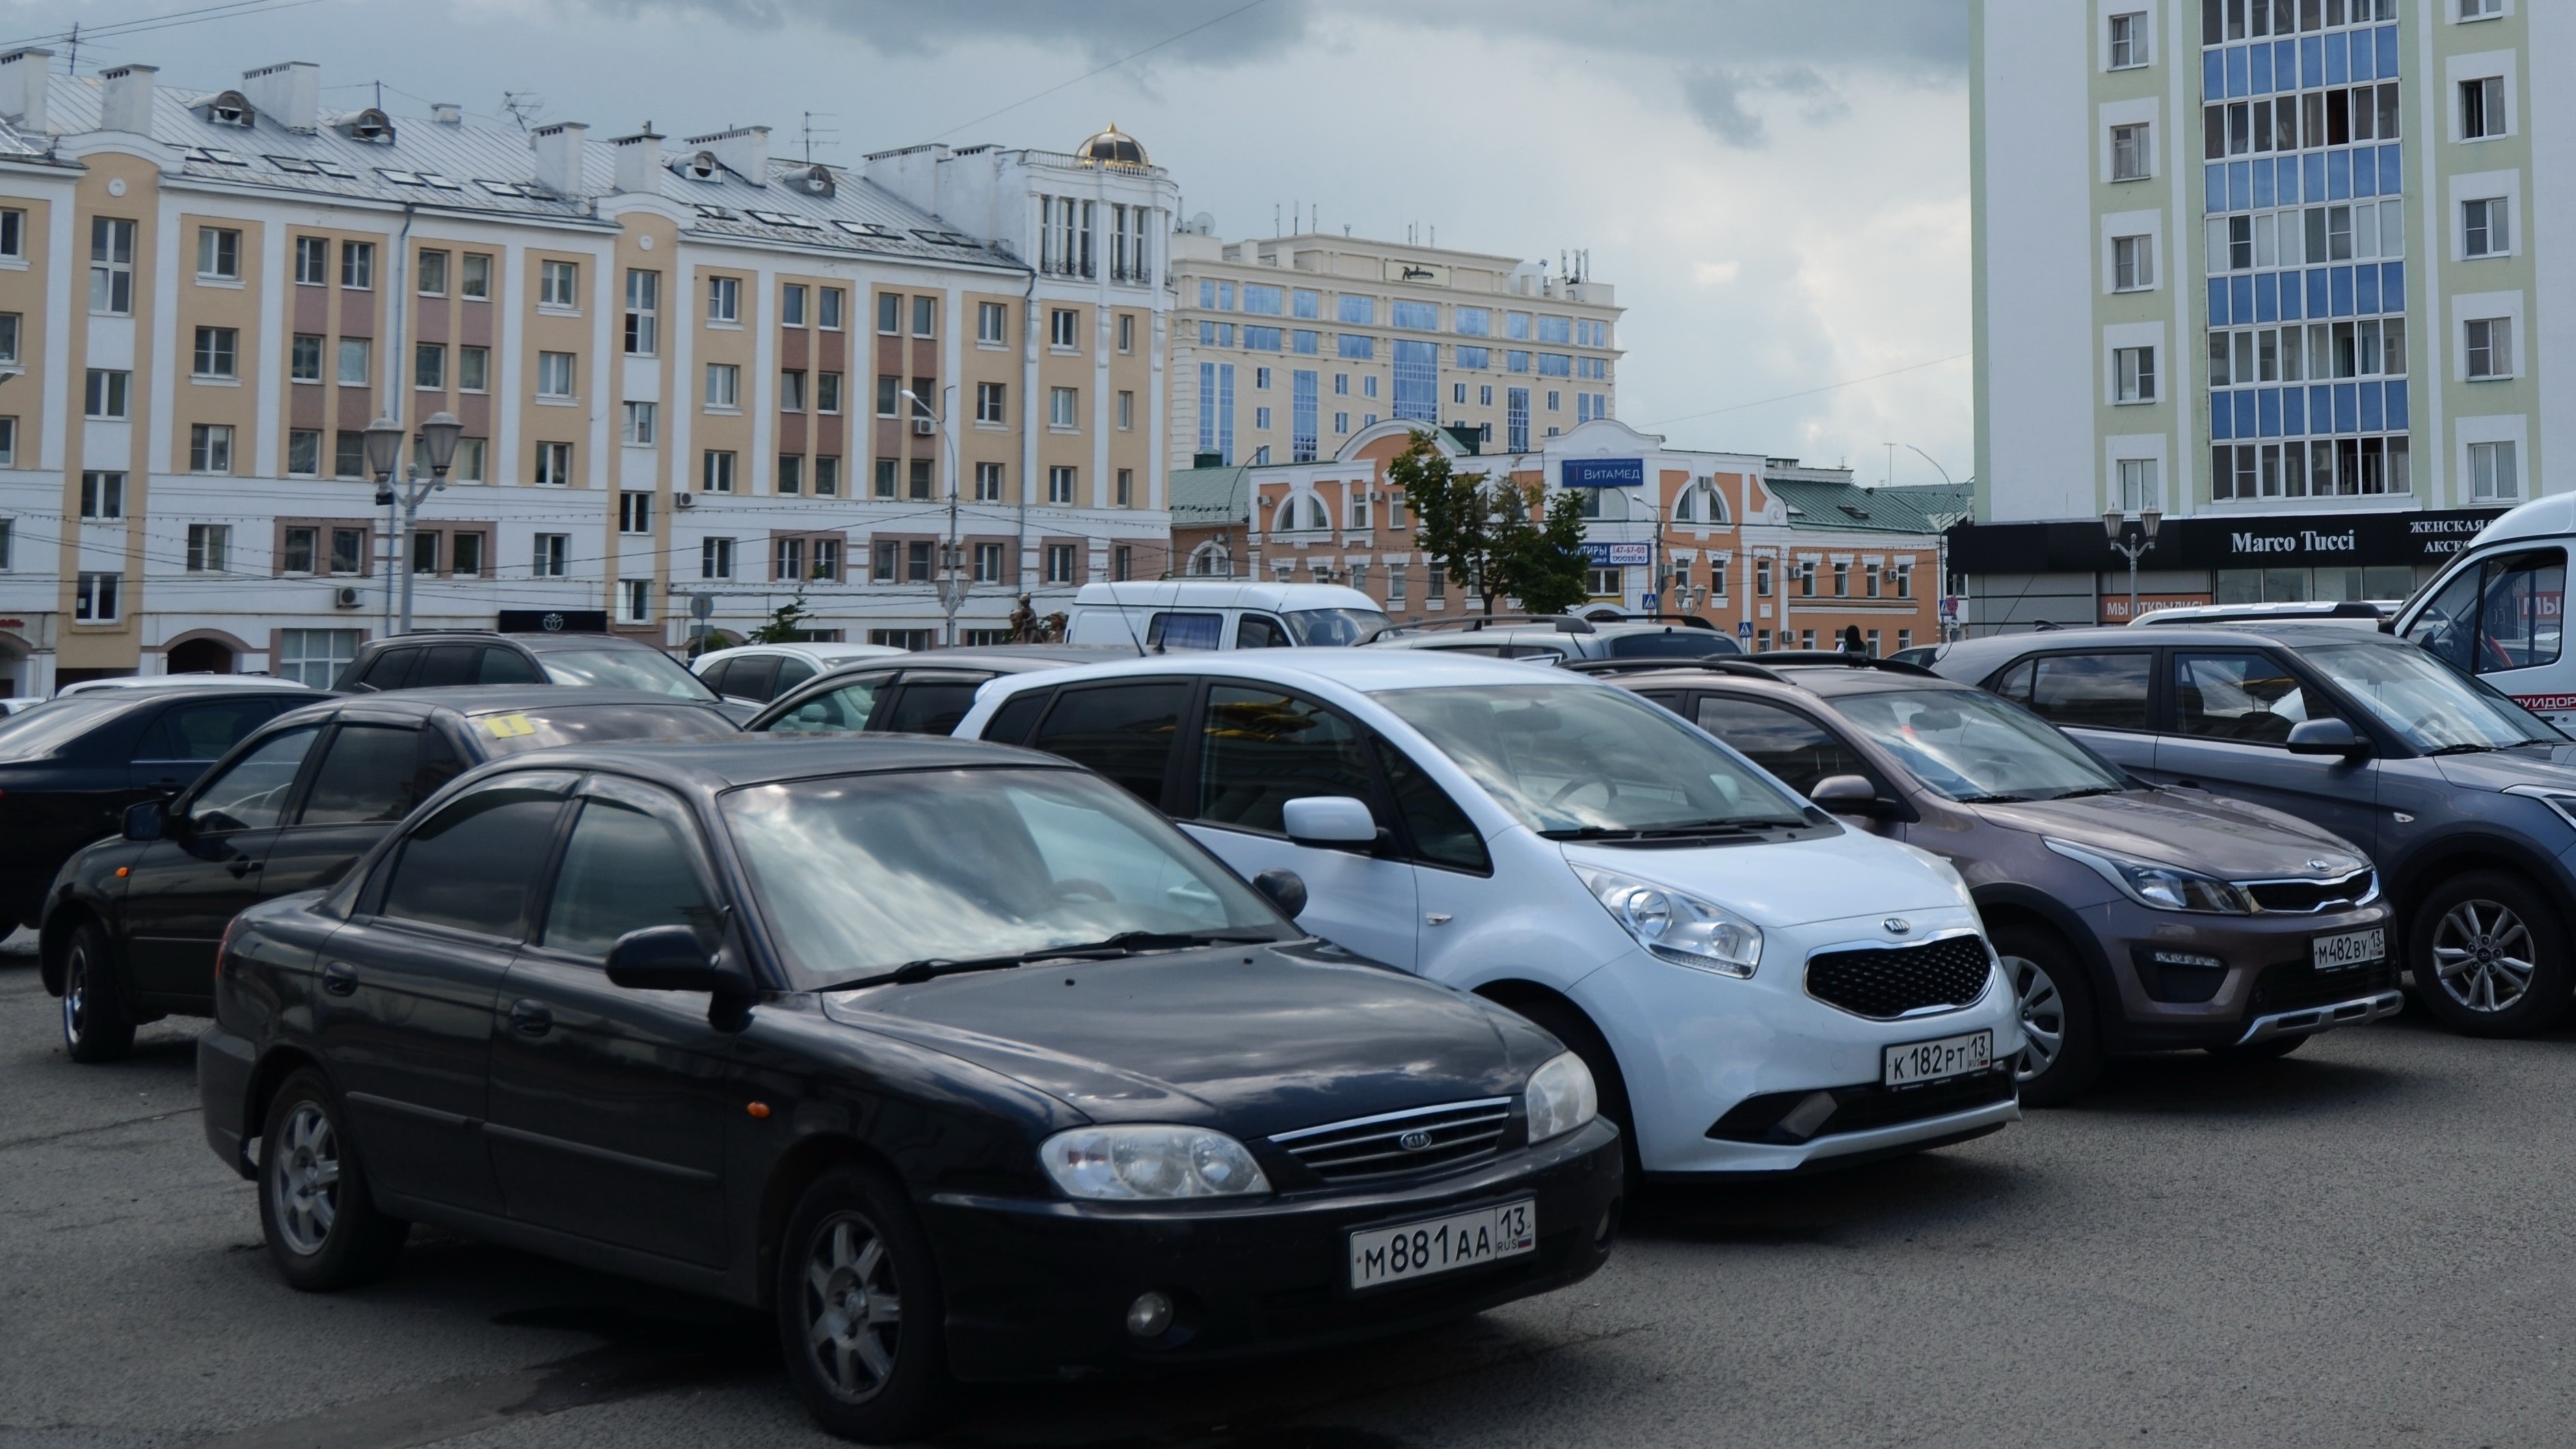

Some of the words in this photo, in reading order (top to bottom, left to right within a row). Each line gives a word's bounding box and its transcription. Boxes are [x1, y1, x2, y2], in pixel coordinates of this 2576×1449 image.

[2410, 519, 2484, 533] ЖЕНСКАЯ
[2231, 532, 2296, 553] Marco
[2300, 529, 2355, 551] Tucci
[2107, 601, 2128, 615] МЫ
[2370, 930, 2381, 949] 13
[1971, 1035, 1985, 1058] 13
[1500, 1206, 1525, 1238] 13
[1497, 1238, 1518, 1253] RUS
